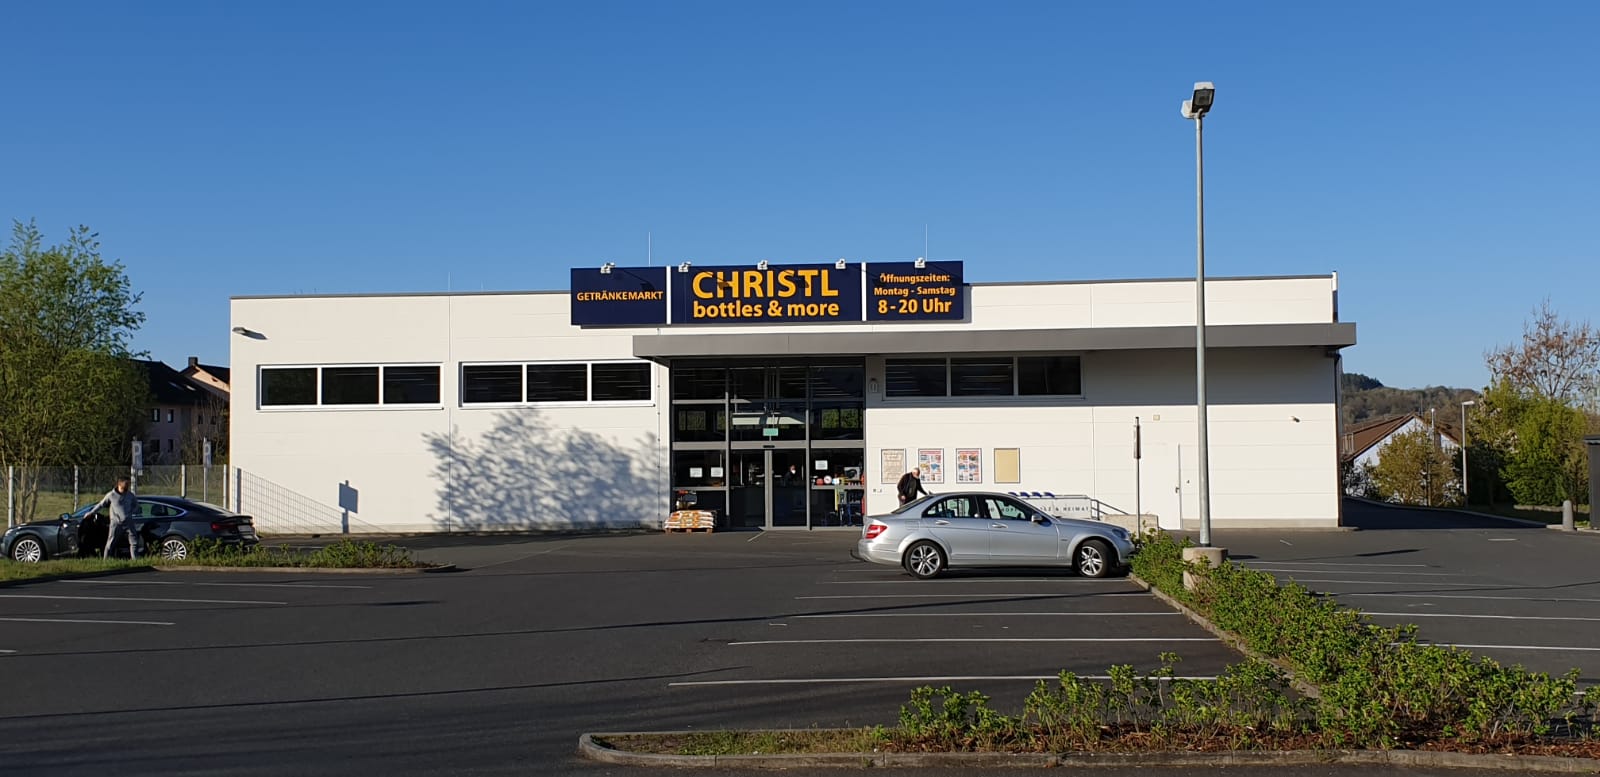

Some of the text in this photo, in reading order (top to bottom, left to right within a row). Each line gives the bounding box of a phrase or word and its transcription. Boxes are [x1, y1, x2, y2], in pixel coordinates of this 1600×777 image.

[692, 268, 839, 299] CHRISTL
[880, 273, 951, 284] Öffnungszeiten:
[577, 289, 664, 301] GETRÄNKEMARKT
[874, 287, 909, 297] Montag
[916, 286, 956, 296] Samstag
[693, 299, 839, 319] bottles & more
[922, 297, 952, 313] Uhr
